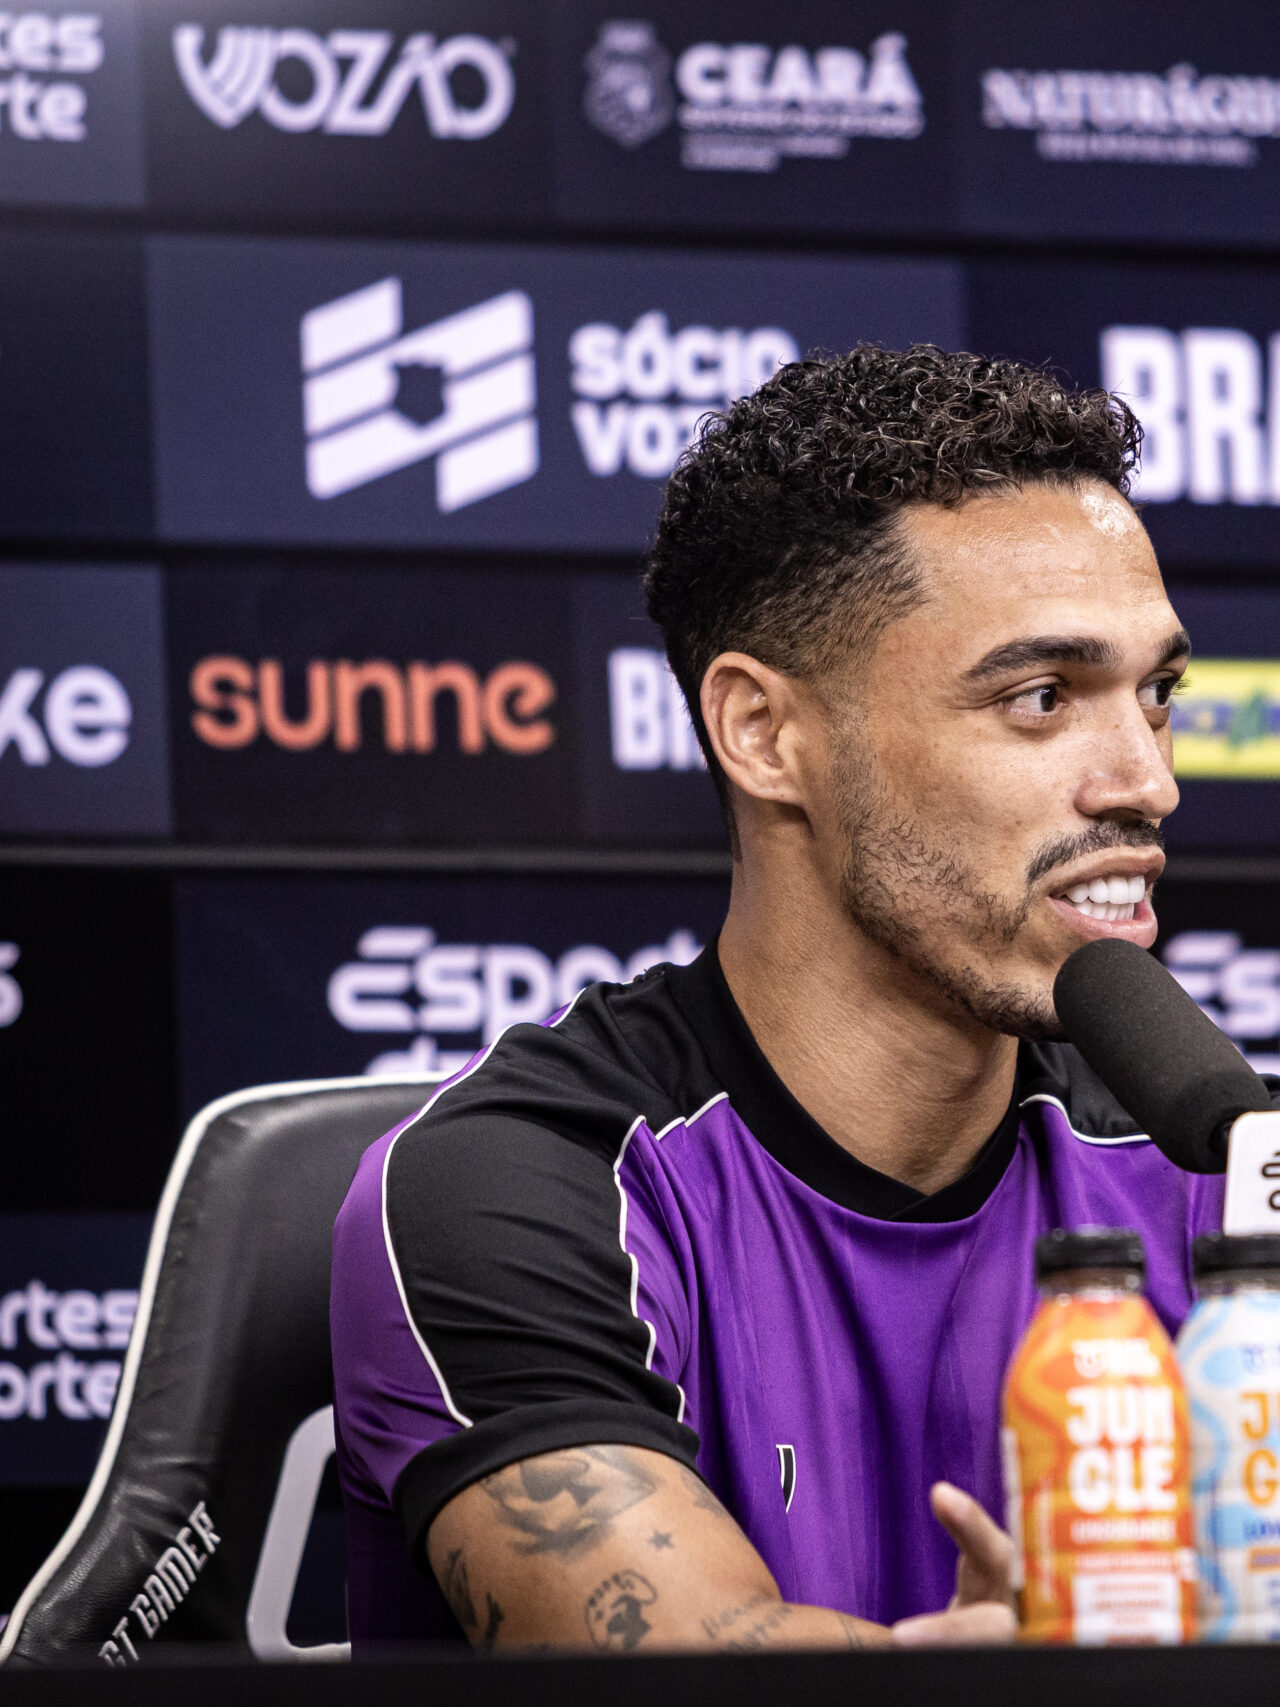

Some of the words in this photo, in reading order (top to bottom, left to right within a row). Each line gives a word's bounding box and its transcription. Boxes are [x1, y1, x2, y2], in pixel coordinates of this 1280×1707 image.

[677, 33, 922, 104] CEARÁ
[190, 655, 557, 755] sunne
[128, 1500, 222, 1640] GAMER
